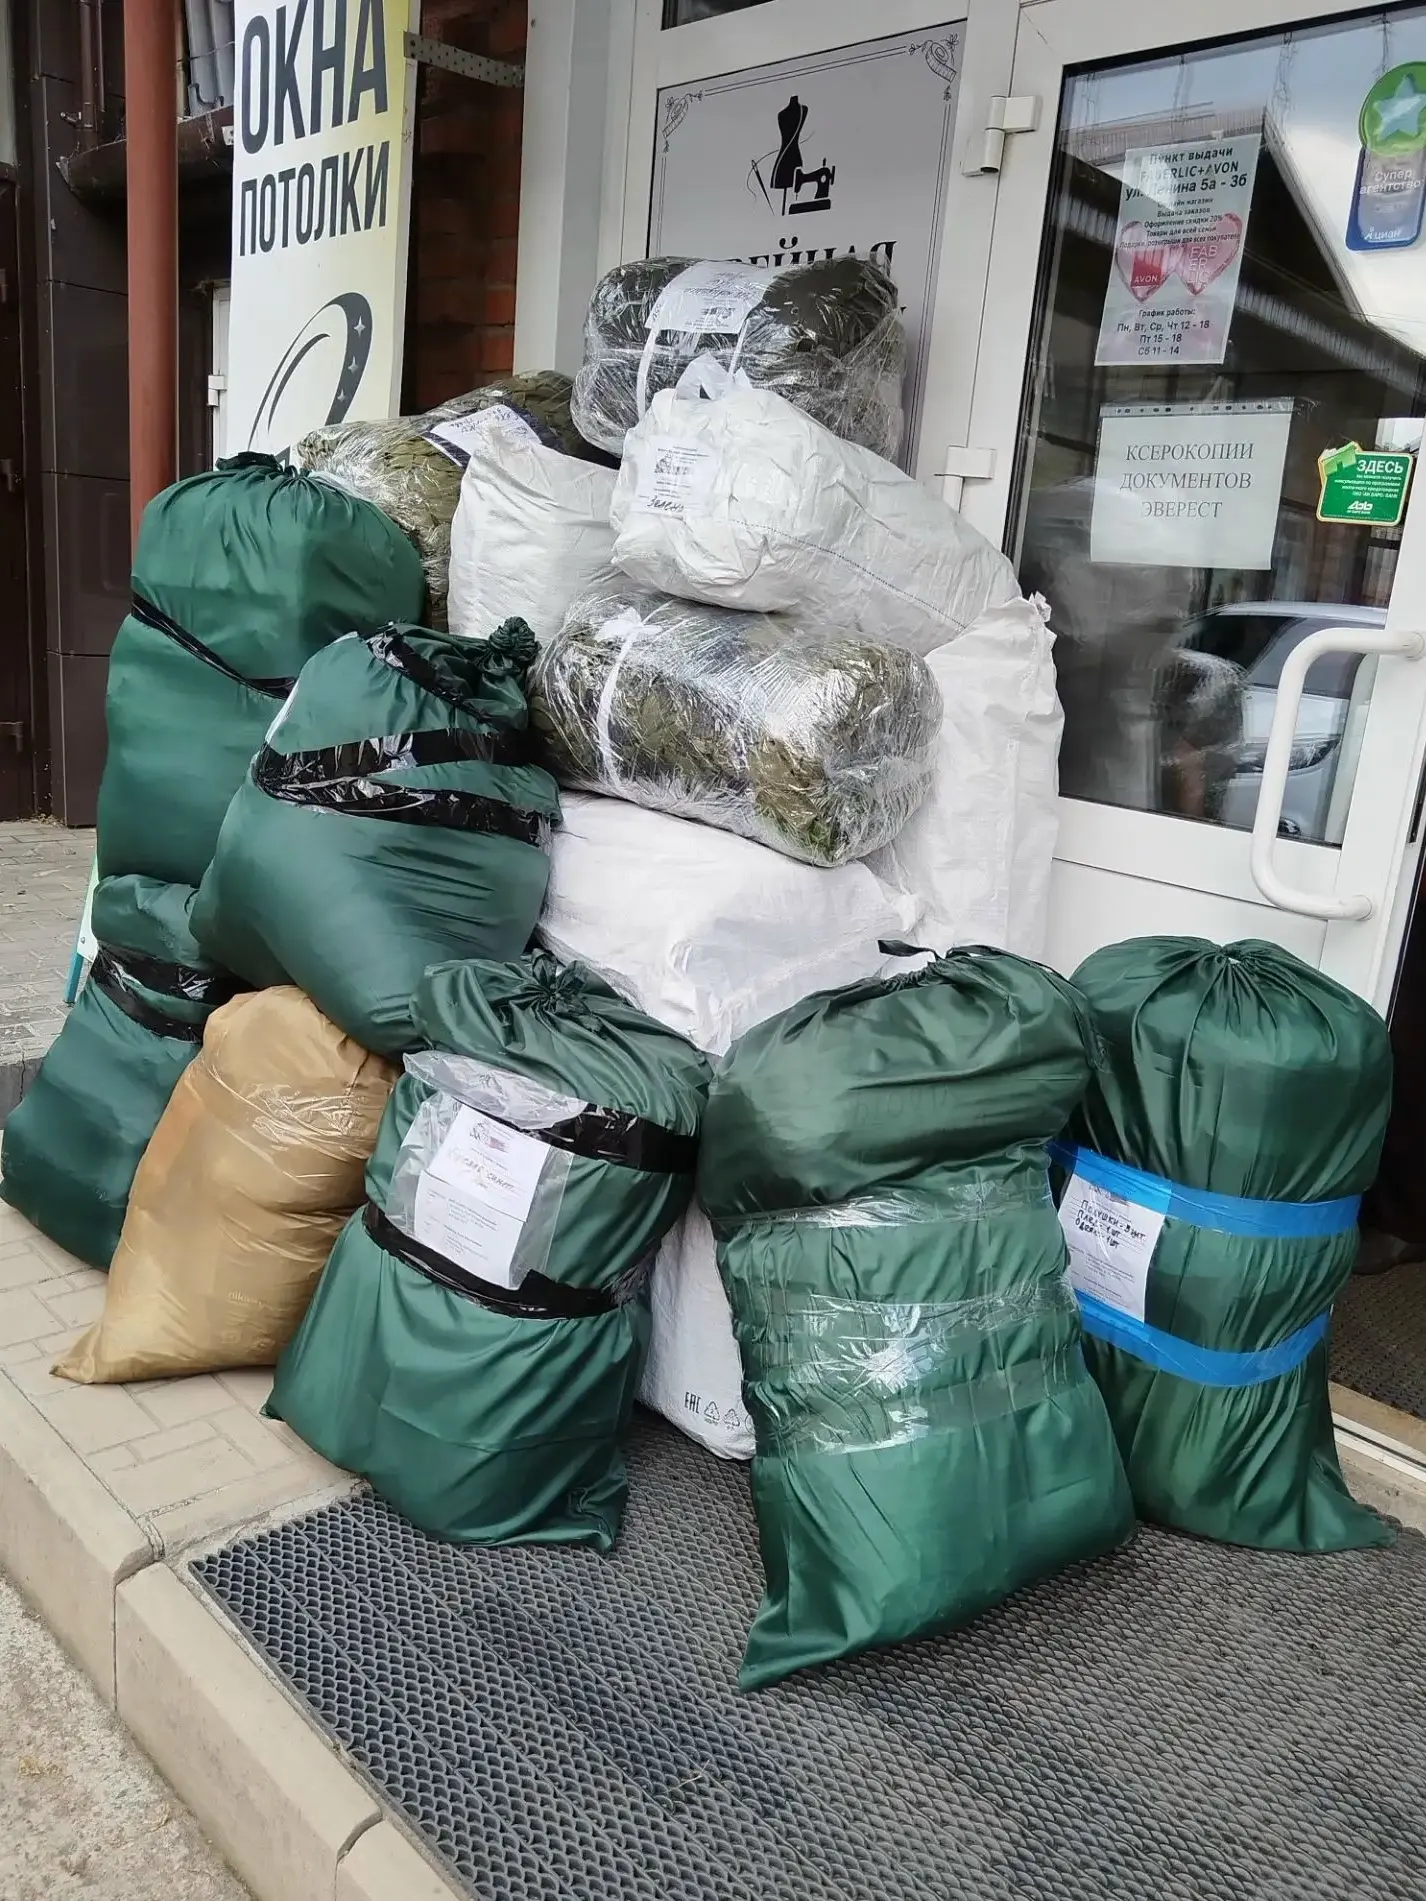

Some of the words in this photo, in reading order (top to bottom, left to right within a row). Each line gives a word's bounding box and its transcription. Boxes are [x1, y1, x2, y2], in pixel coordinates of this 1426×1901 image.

[241, 0, 389, 155] ОКНА
[1188, 147, 1233, 161] выдачи
[1141, 161, 1239, 182] FERLIC+AVON
[1374, 169, 1414, 183] Супер
[1152, 181, 1196, 195] енина
[1200, 179, 1216, 191] 5а
[1360, 179, 1422, 195] агентство
[239, 141, 390, 257] ПОТОЛКИ
[1157, 209, 1183, 218] Выдача
[1183, 207, 1211, 216] заказов
[1144, 218, 1185, 230] Оформление
[1185, 216, 1209, 226] скидки
[1146, 229, 1168, 238] Товары
[1168, 228, 1181, 236] для
[1182, 226, 1197, 234] всей
[1374, 229, 1401, 240] циан
[1133, 275, 1158, 283] AVON
[1138, 309, 1165, 318] График
[1166, 308, 1196, 318] работы:
[1117, 323, 1131, 333] Пн,
[1134, 322, 1147, 332] Вт,
[1149, 322, 1164, 332] Ср,
[1167, 321, 1178, 331] Чт
[1181, 321, 1190, 330] 12
[1200, 320, 1210, 329] 18
[1139, 334, 1151, 344] Пт
[1153, 334, 1163, 343] 15
[1172, 333, 1182, 342] 18
[1138, 346, 1150, 356] Сб
[1153, 346, 1161, 355] 11
[1170, 346, 1180, 355] 14
[1126, 442, 1255, 461] КСЕРОКОПИИ
[1356, 459, 1404, 475] ЗДЕСЬ
[1119, 472, 1252, 491] ДОКУМЕНТОВ
[1141, 501, 1223, 518] ЭВЕРЕСТ
